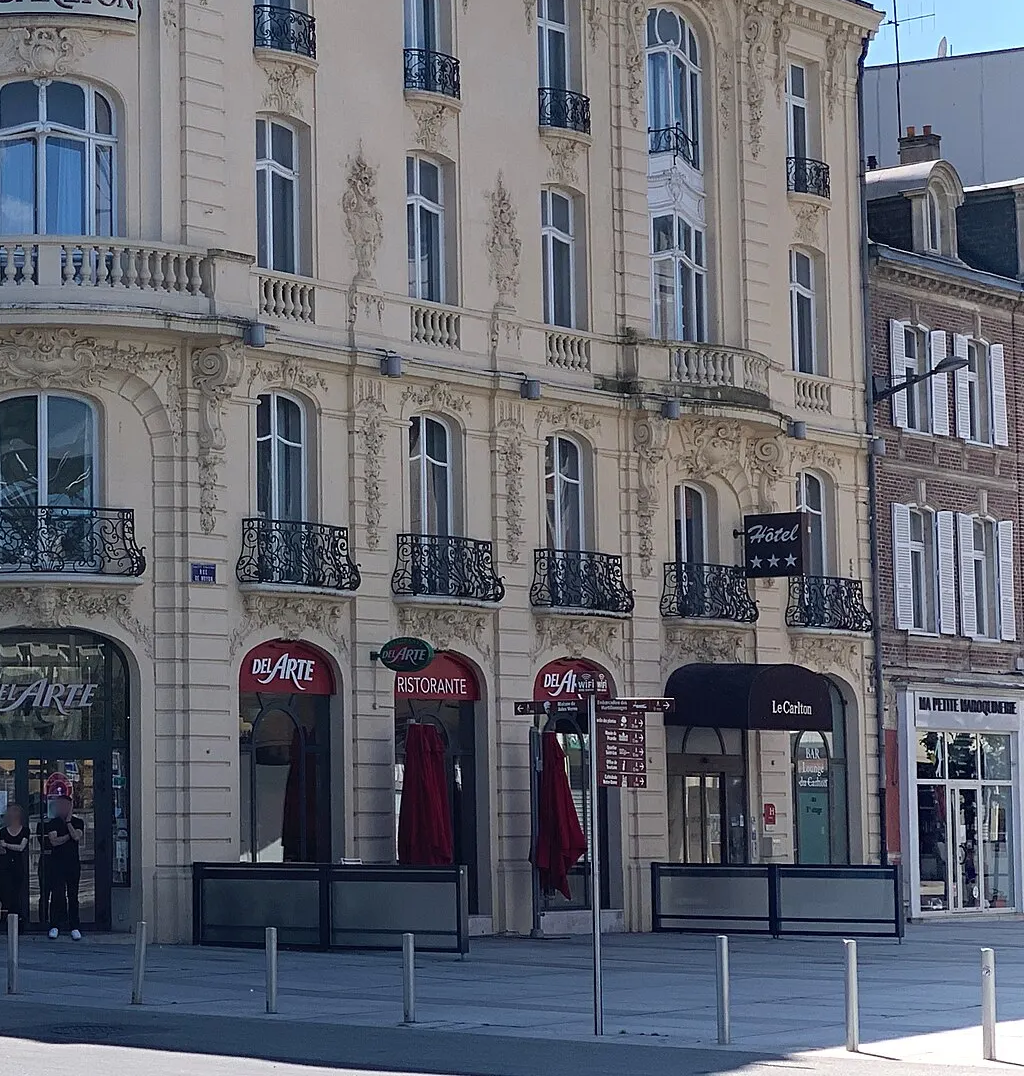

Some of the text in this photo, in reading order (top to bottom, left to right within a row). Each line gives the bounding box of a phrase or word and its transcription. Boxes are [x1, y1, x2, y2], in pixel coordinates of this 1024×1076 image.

[747, 524, 799, 543] Hôtel
[256, 652, 316, 691] ARTE
[397, 676, 467, 694] RISTORANTE
[772, 700, 812, 715] Le Carlton
[919, 697, 1017, 716] MA PETITE MAROQUINERIE
[805, 748, 820, 759] BAR
